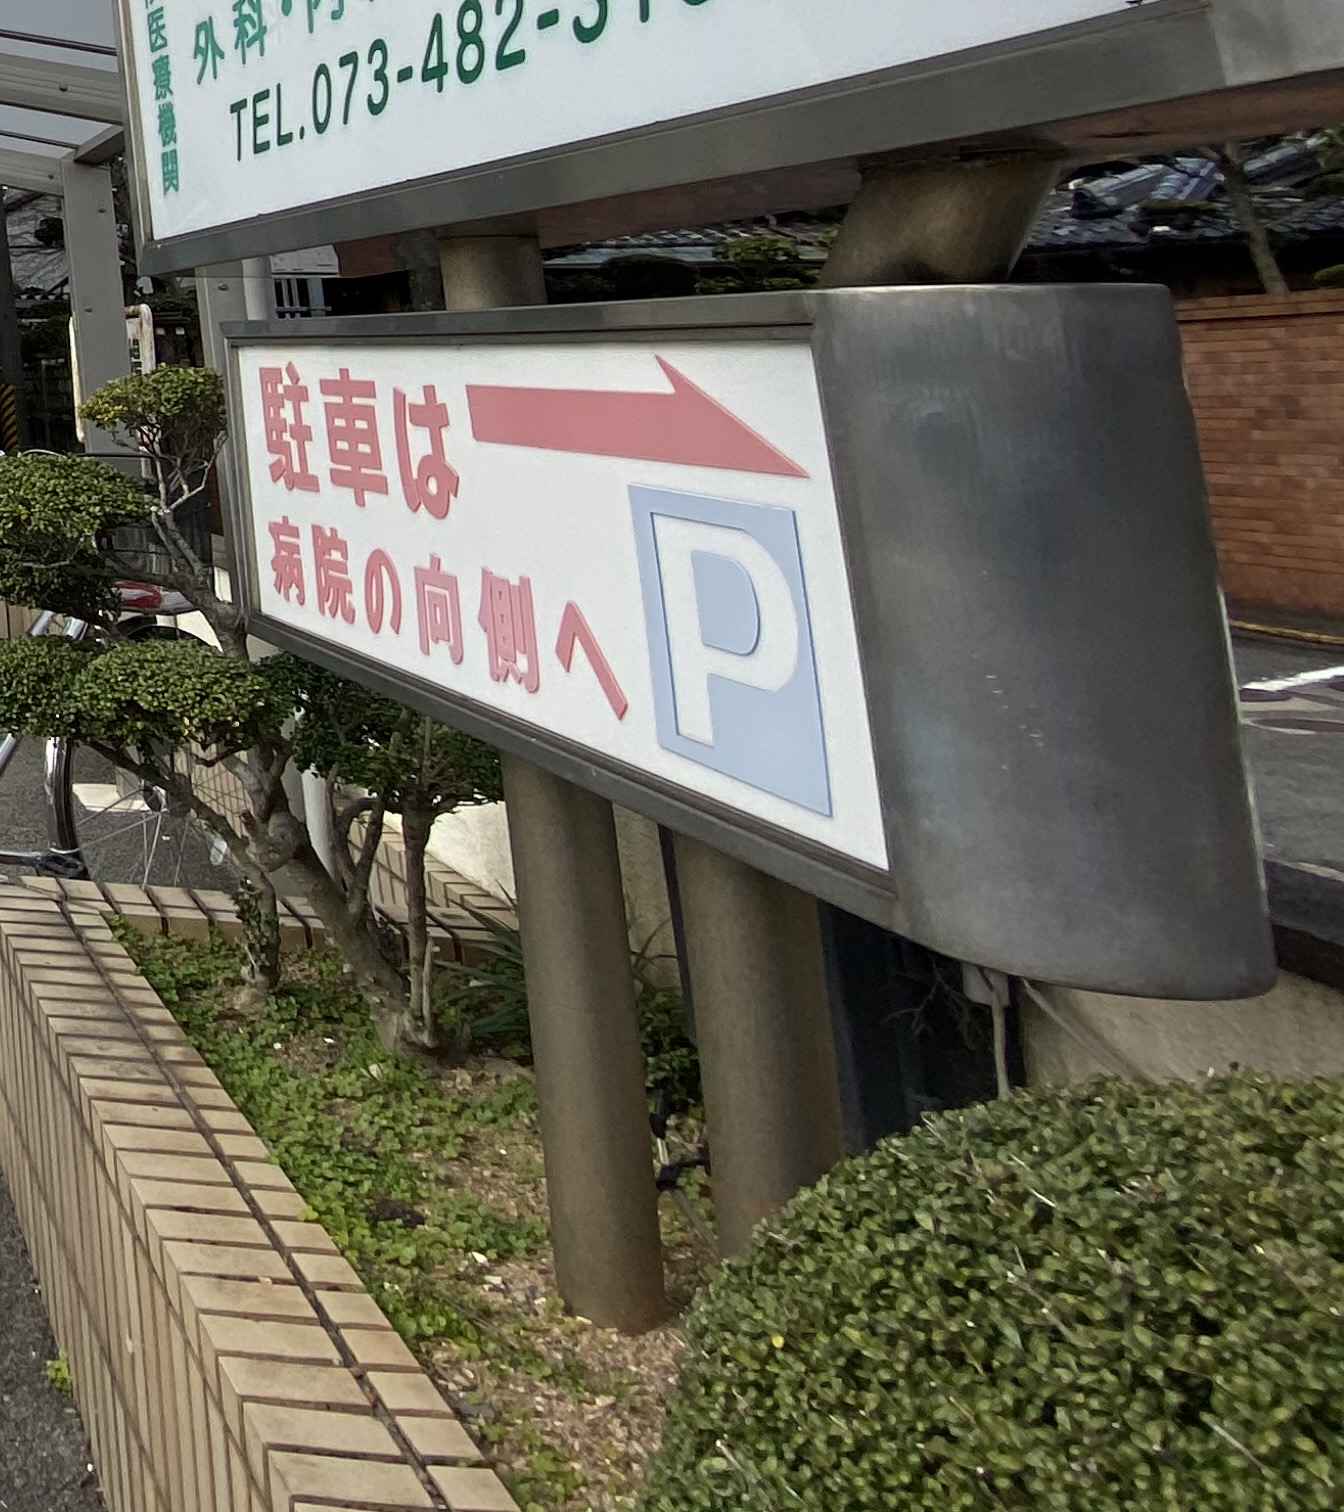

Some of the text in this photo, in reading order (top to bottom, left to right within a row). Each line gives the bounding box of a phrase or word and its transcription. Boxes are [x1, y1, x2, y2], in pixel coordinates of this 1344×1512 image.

[258, 361, 460, 520] 駐車は
[266, 515, 629, 721] 病院の向側へ
[650, 511, 799, 748] P
